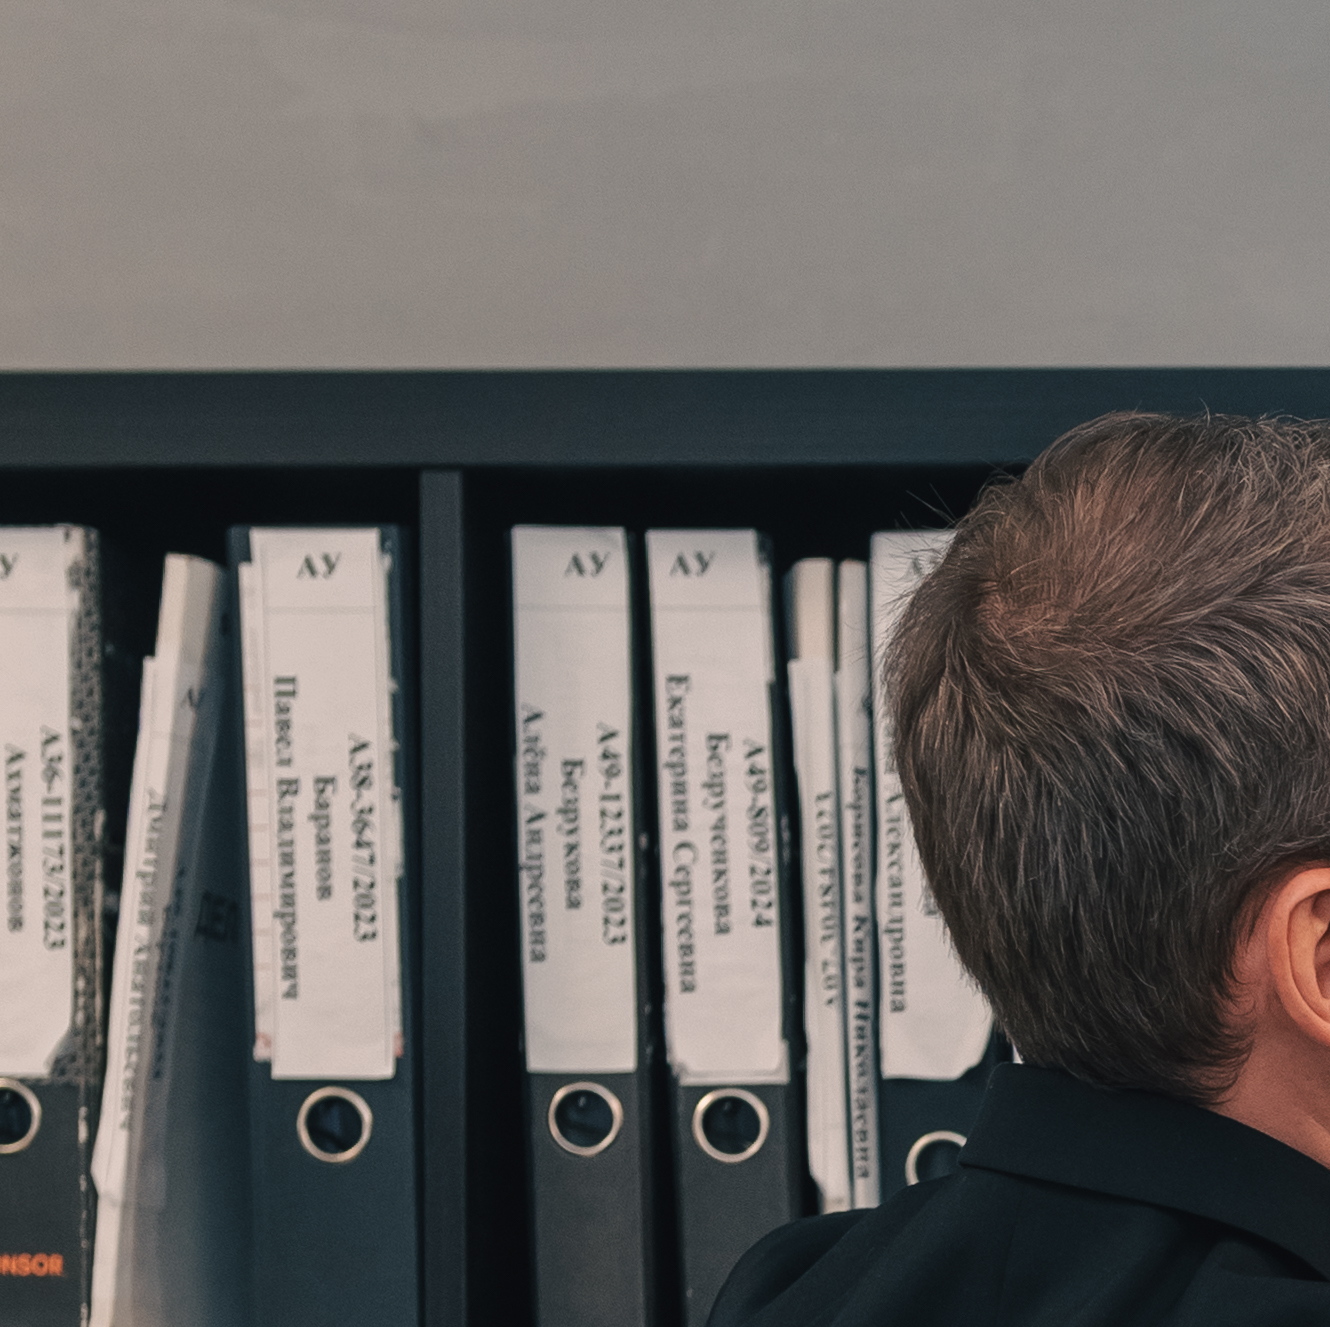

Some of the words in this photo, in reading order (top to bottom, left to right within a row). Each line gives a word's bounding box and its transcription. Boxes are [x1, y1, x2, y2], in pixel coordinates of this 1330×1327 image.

[296, 553, 345, 580] АУ
[563, 549, 613, 578] АУ
[669, 549, 716, 578] АУ
[272, 675, 301, 768] Павел
[518, 702, 549, 796] Алёна
[659, 674, 696, 833] Екатерина
[272, 777, 308, 1001] Владимирович
[305, 775, 342, 902] Баранов
[347, 737, 380, 943] А38-3647/2023
[521, 803, 553, 965] Андреевна
[553, 758, 590, 911] Безрукова
[596, 728, 628, 946] А49-12337/2023
[698, 732, 737, 936] Безрученкова
[666, 840, 701, 994] Сергеевна
